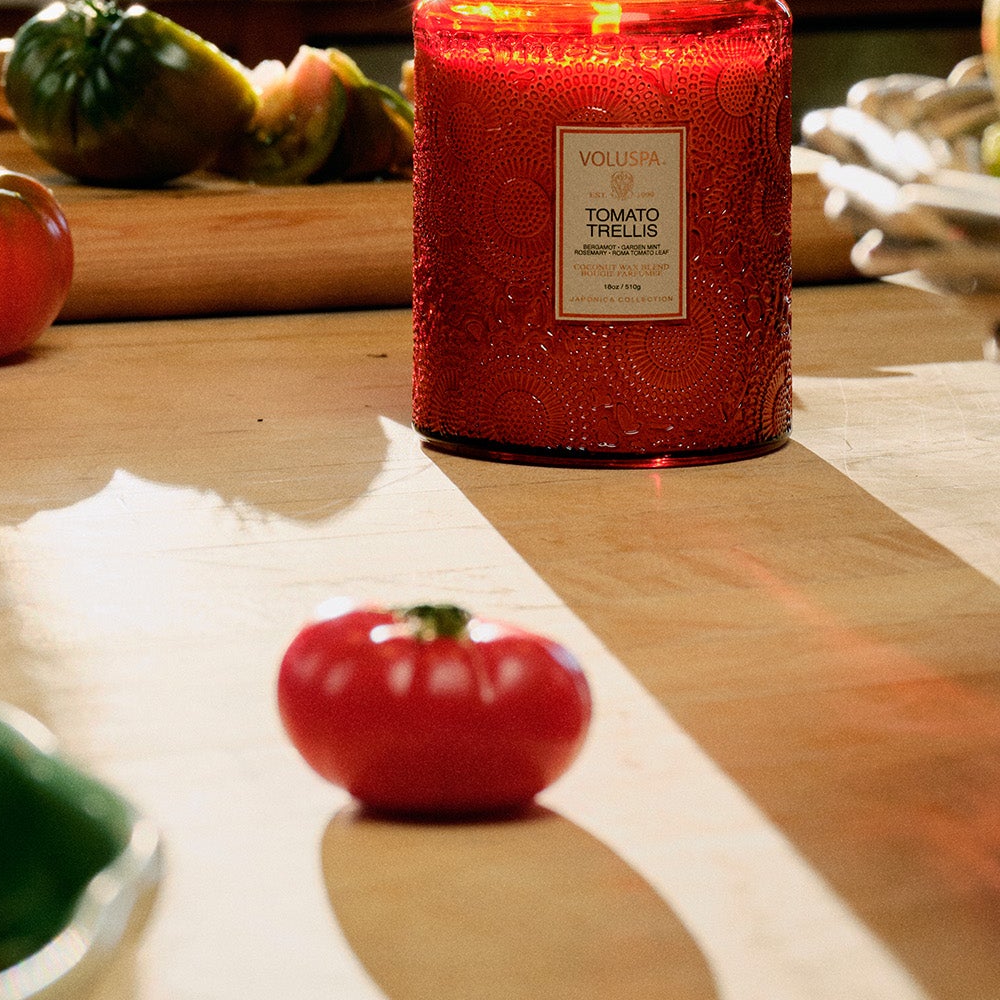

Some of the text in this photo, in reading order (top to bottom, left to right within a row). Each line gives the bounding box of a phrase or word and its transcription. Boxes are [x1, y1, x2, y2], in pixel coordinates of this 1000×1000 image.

[585, 208, 660, 222] TOMATO
[586, 224, 658, 237] TRELLIS
[617, 295, 673, 303] COLLECTION
